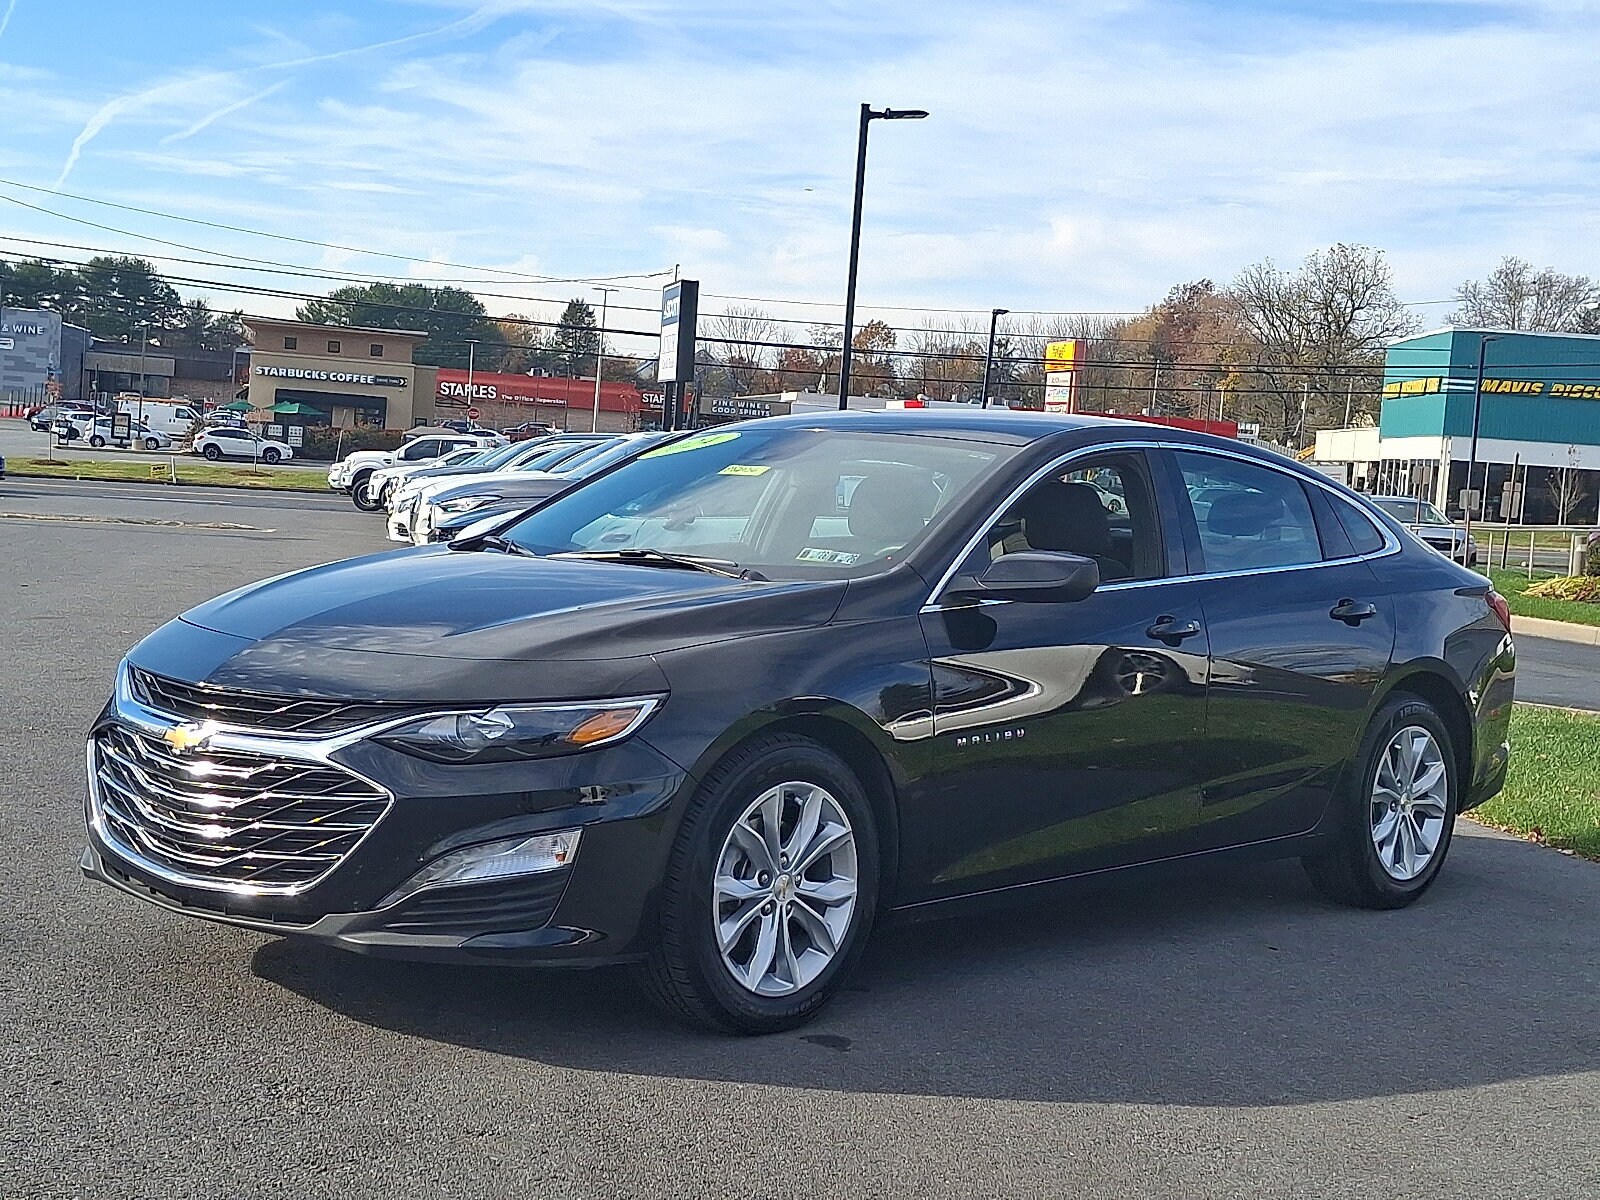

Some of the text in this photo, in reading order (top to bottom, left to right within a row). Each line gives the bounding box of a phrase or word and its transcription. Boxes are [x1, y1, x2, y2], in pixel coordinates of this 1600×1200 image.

[1, 323, 44, 335] & WINE
[255, 366, 327, 380] STARBUCKS
[329, 372, 375, 384] COFFEE
[440, 382, 497, 399] STAPLES
[1481, 379, 1544, 395] MAVIS
[712, 399, 734, 407] FINE
[737, 401, 762, 409] WINE
[712, 406, 770, 417] GOOD SPIRITS
[957, 728, 1025, 746] MALIBU
